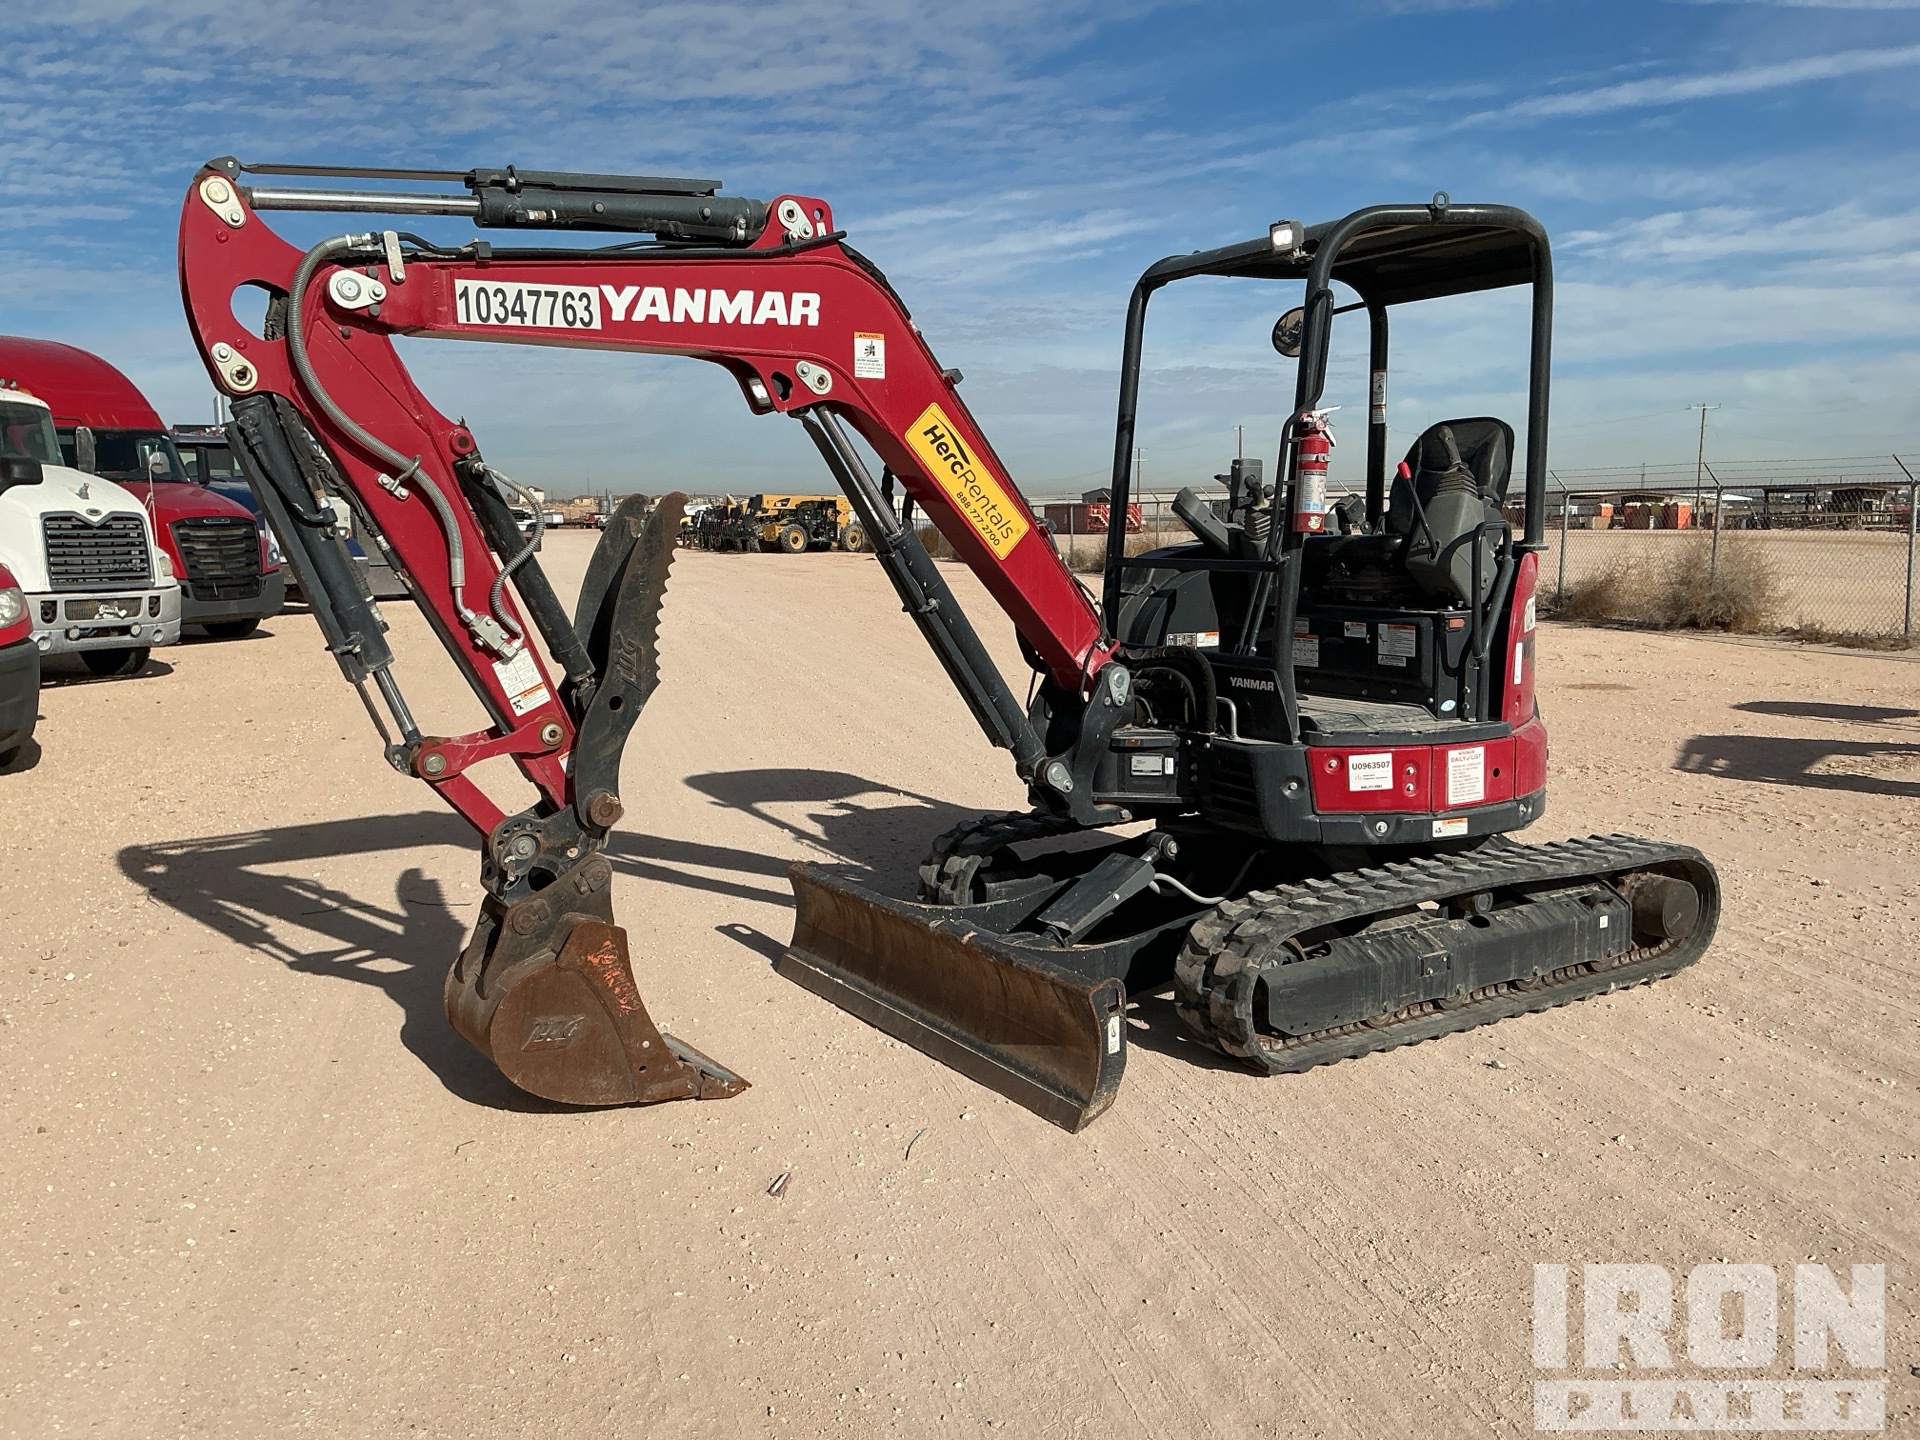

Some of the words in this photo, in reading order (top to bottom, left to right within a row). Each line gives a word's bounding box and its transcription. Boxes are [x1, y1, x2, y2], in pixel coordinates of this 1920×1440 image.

[458, 285, 594, 327] 10347763
[600, 285, 821, 326] YANMAR
[922, 424, 1014, 539] HercRentals
[1229, 676, 1275, 692] YANMAR
[1352, 761, 1390, 770] U0963507
